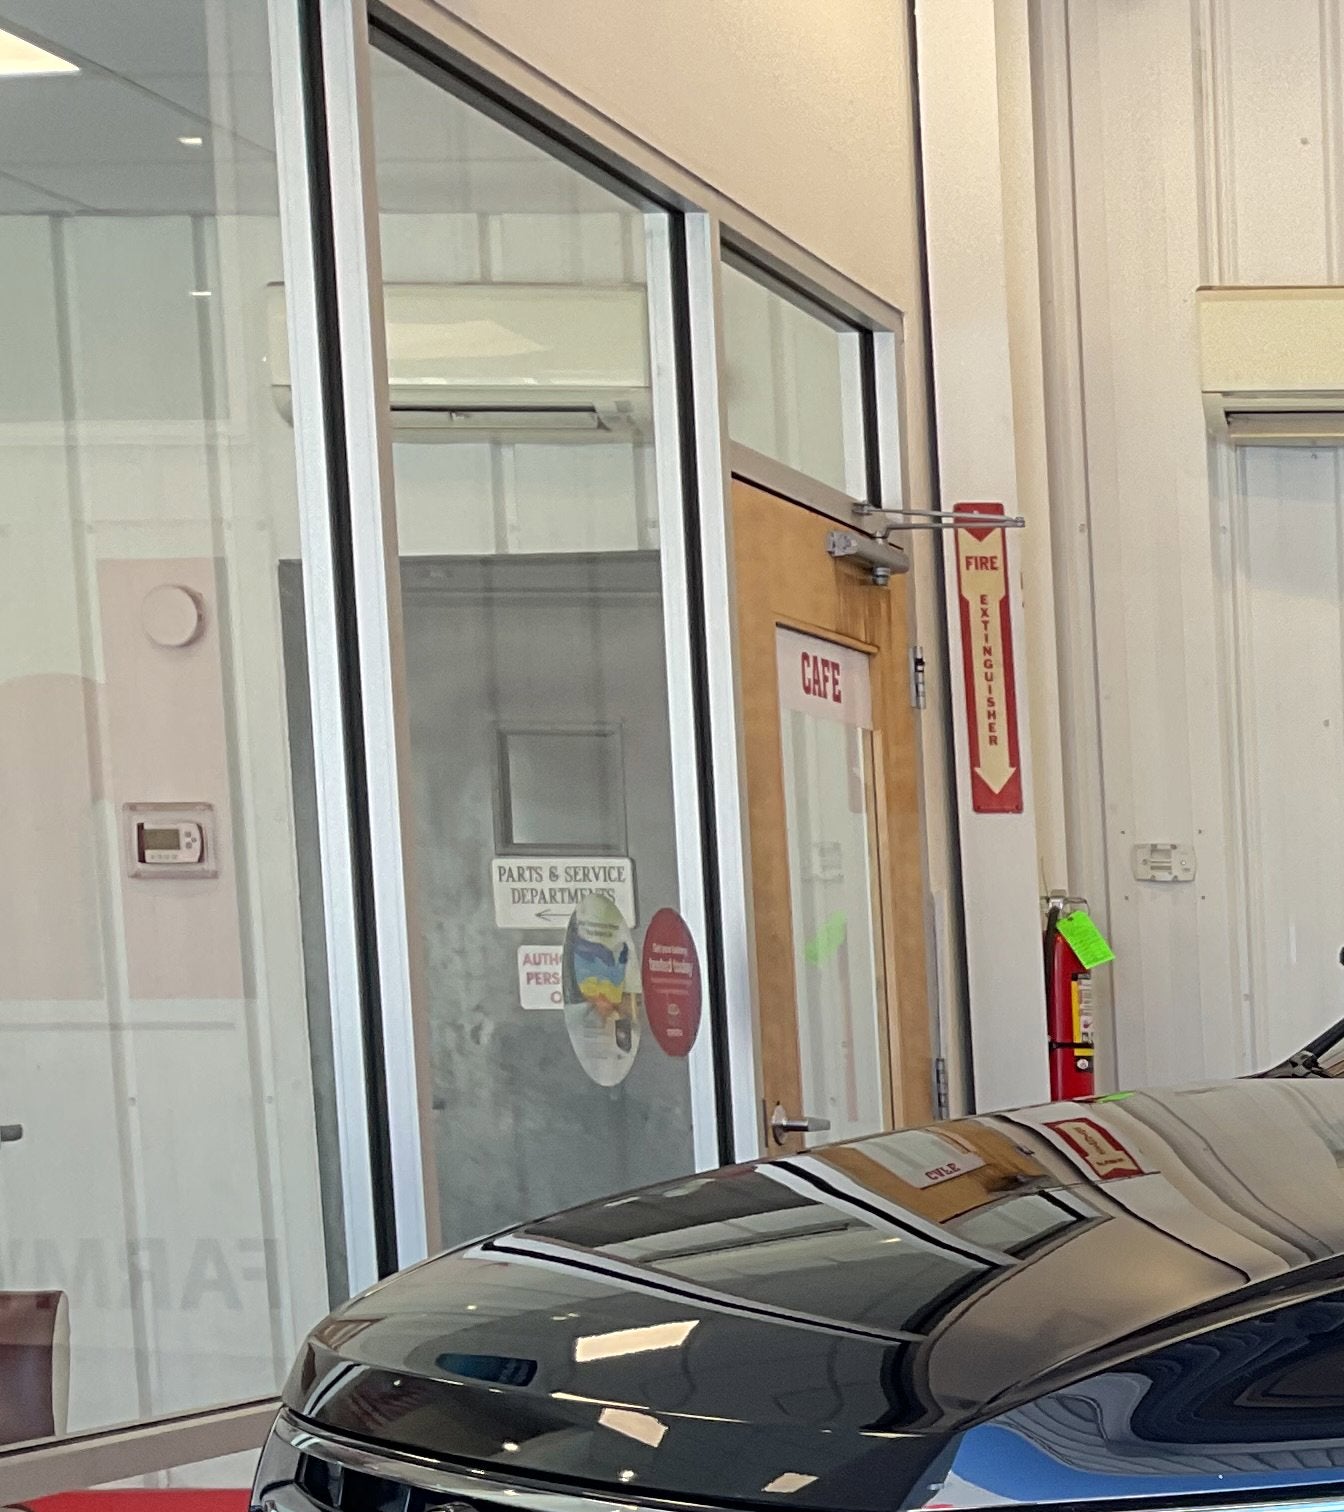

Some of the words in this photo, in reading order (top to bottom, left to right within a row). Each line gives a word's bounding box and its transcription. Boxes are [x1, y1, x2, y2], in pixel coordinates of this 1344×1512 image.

[965, 555, 999, 572] FIRE
[801, 651, 842, 704] CAFE
[979, 594, 998, 747] EXTINGUISHER
[497, 865, 543, 883] PARTS
[548, 865, 559, 882] &
[564, 866, 626, 883] SERVICE
